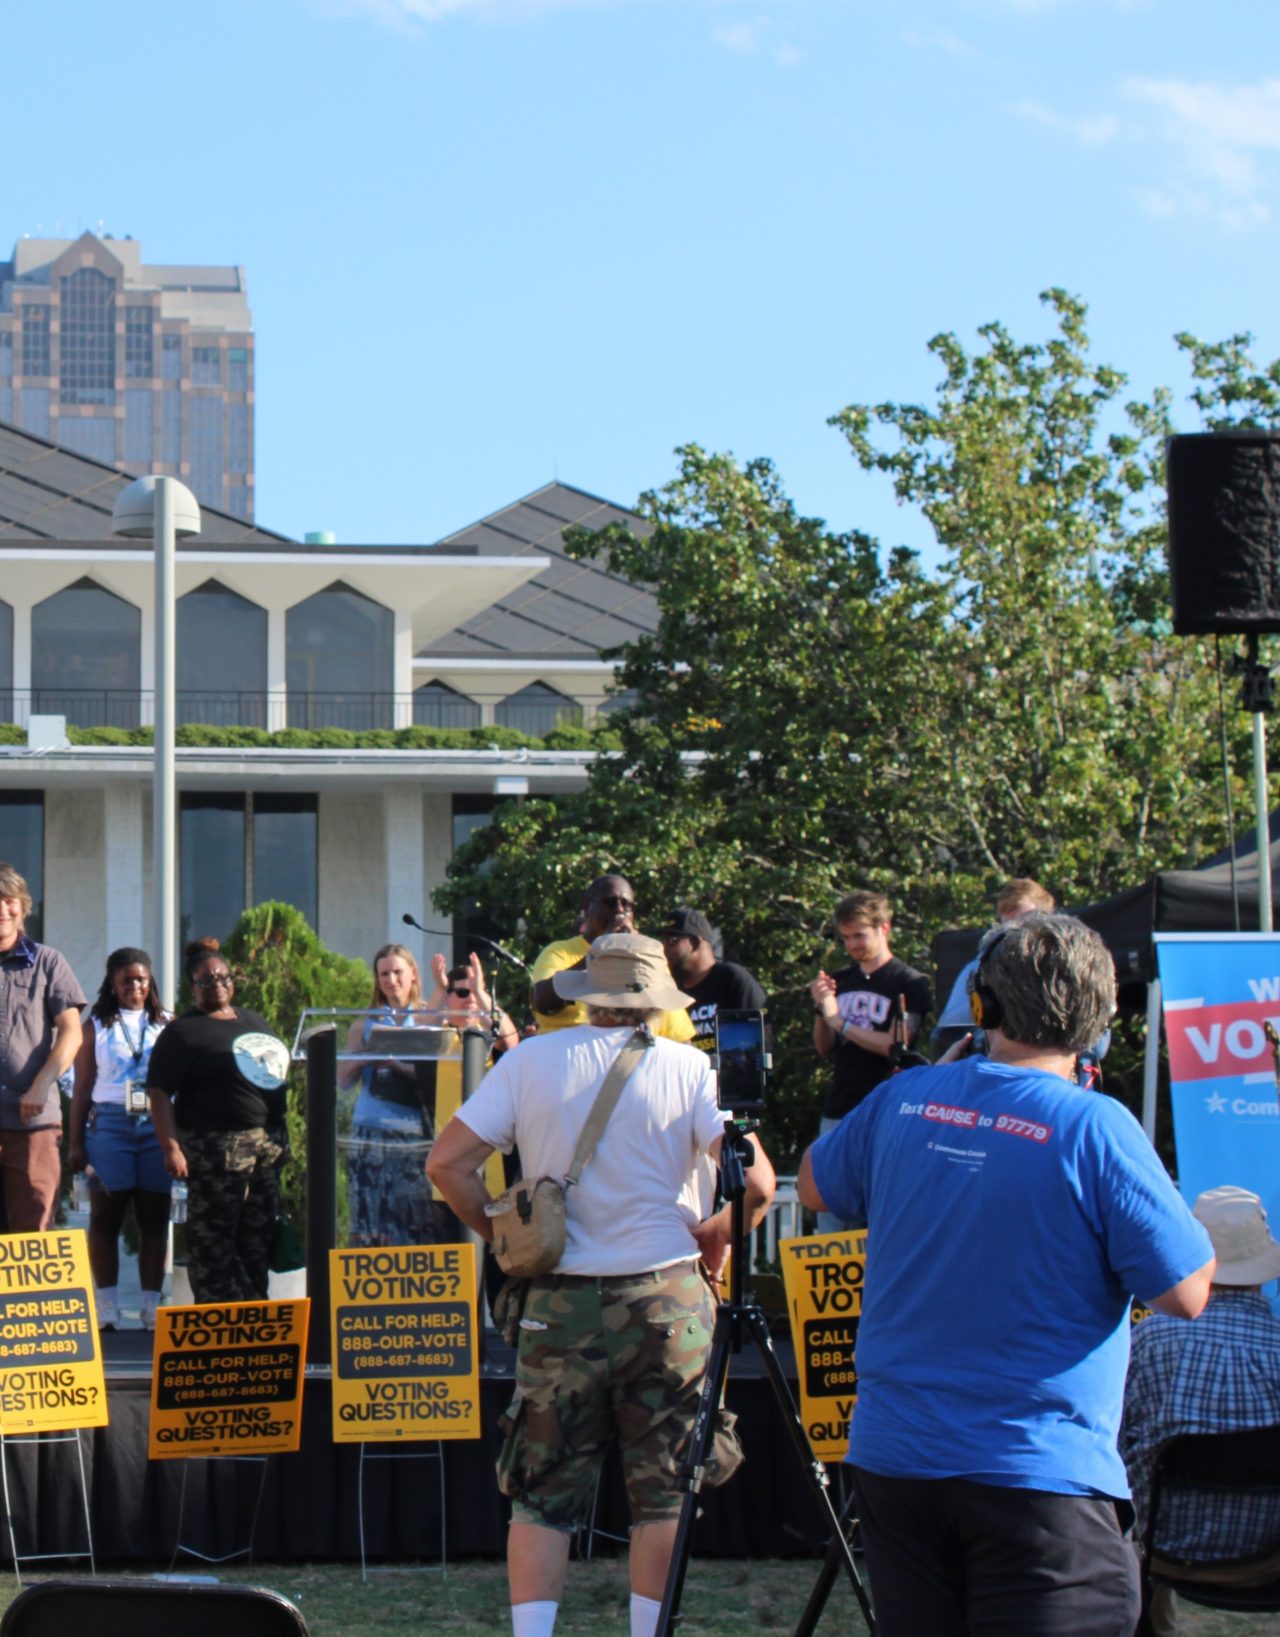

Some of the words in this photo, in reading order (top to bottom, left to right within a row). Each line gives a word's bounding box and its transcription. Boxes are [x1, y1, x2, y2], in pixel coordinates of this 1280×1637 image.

[1231, 1099, 1280, 1116] Com
[899, 1102, 925, 1115] Text
[924, 1105, 975, 1126] CAUSE
[978, 1114, 993, 1127] to
[996, 1116, 1048, 1140] 97779
[339, 1250, 459, 1277] TROUBLE
[343, 1275, 461, 1300] VOTING?
[5, 1302, 39, 1319] FOR
[40, 1299, 86, 1316] HELP:
[166, 1305, 294, 1329] TROUBLE
[341, 1317, 382, 1331] CALL
[385, 1315, 418, 1330] FOR
[421, 1313, 466, 1328] HELP:
[169, 1324, 293, 1348] VOTING?
[342, 1333, 467, 1351] 888-OUR-VOTE
[809, 1330, 853, 1346] CALL
[163, 1360, 207, 1372] CALL
[210, 1356, 245, 1369] FOR
[248, 1353, 294, 1366] HELP:
[354, 1353, 455, 1370] (888-687-8683)
[163, 1369, 293, 1388] 888-OUR-VOTE
[175, 1385, 279, 1402] (888-687-8683)
[365, 1382, 449, 1401] VOTING
[185, 1407, 271, 1426] VOTING
[339, 1400, 473, 1422] QUESTIONS?
[156, 1421, 294, 1443] QUESTIONS?
